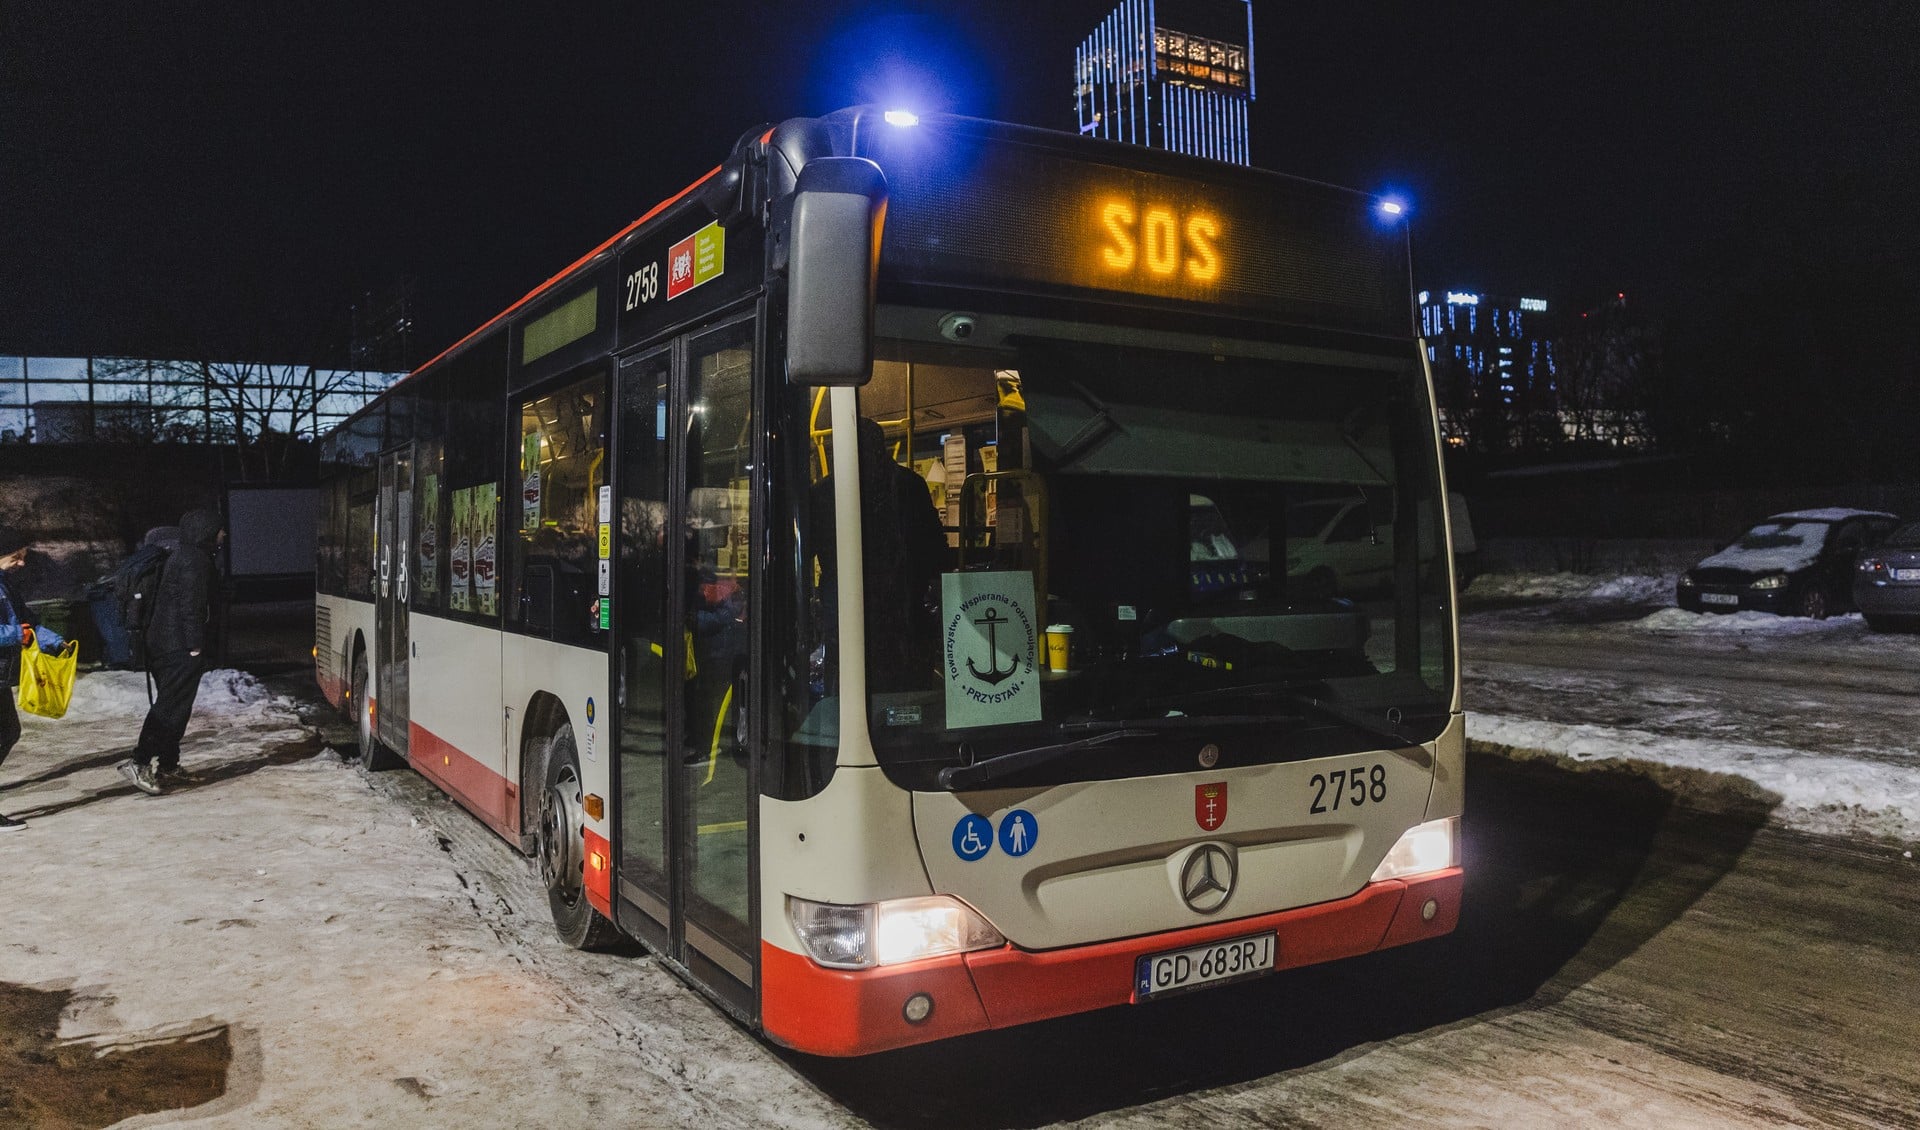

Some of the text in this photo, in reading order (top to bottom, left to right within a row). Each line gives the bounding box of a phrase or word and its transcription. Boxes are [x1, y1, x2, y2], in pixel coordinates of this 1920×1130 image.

[1102, 203, 1218, 280] SOS
[625, 261, 659, 311] 2758
[943, 592, 1036, 681] Towarzystwo Wspierania Potrzebujących
[966, 682, 1021, 704] PRZYSTAŃ
[1308, 763, 1388, 815] 2758
[1140, 979, 1150, 988] PL
[1155, 954, 1191, 987] GD
[1199, 938, 1269, 978] 683RJ
